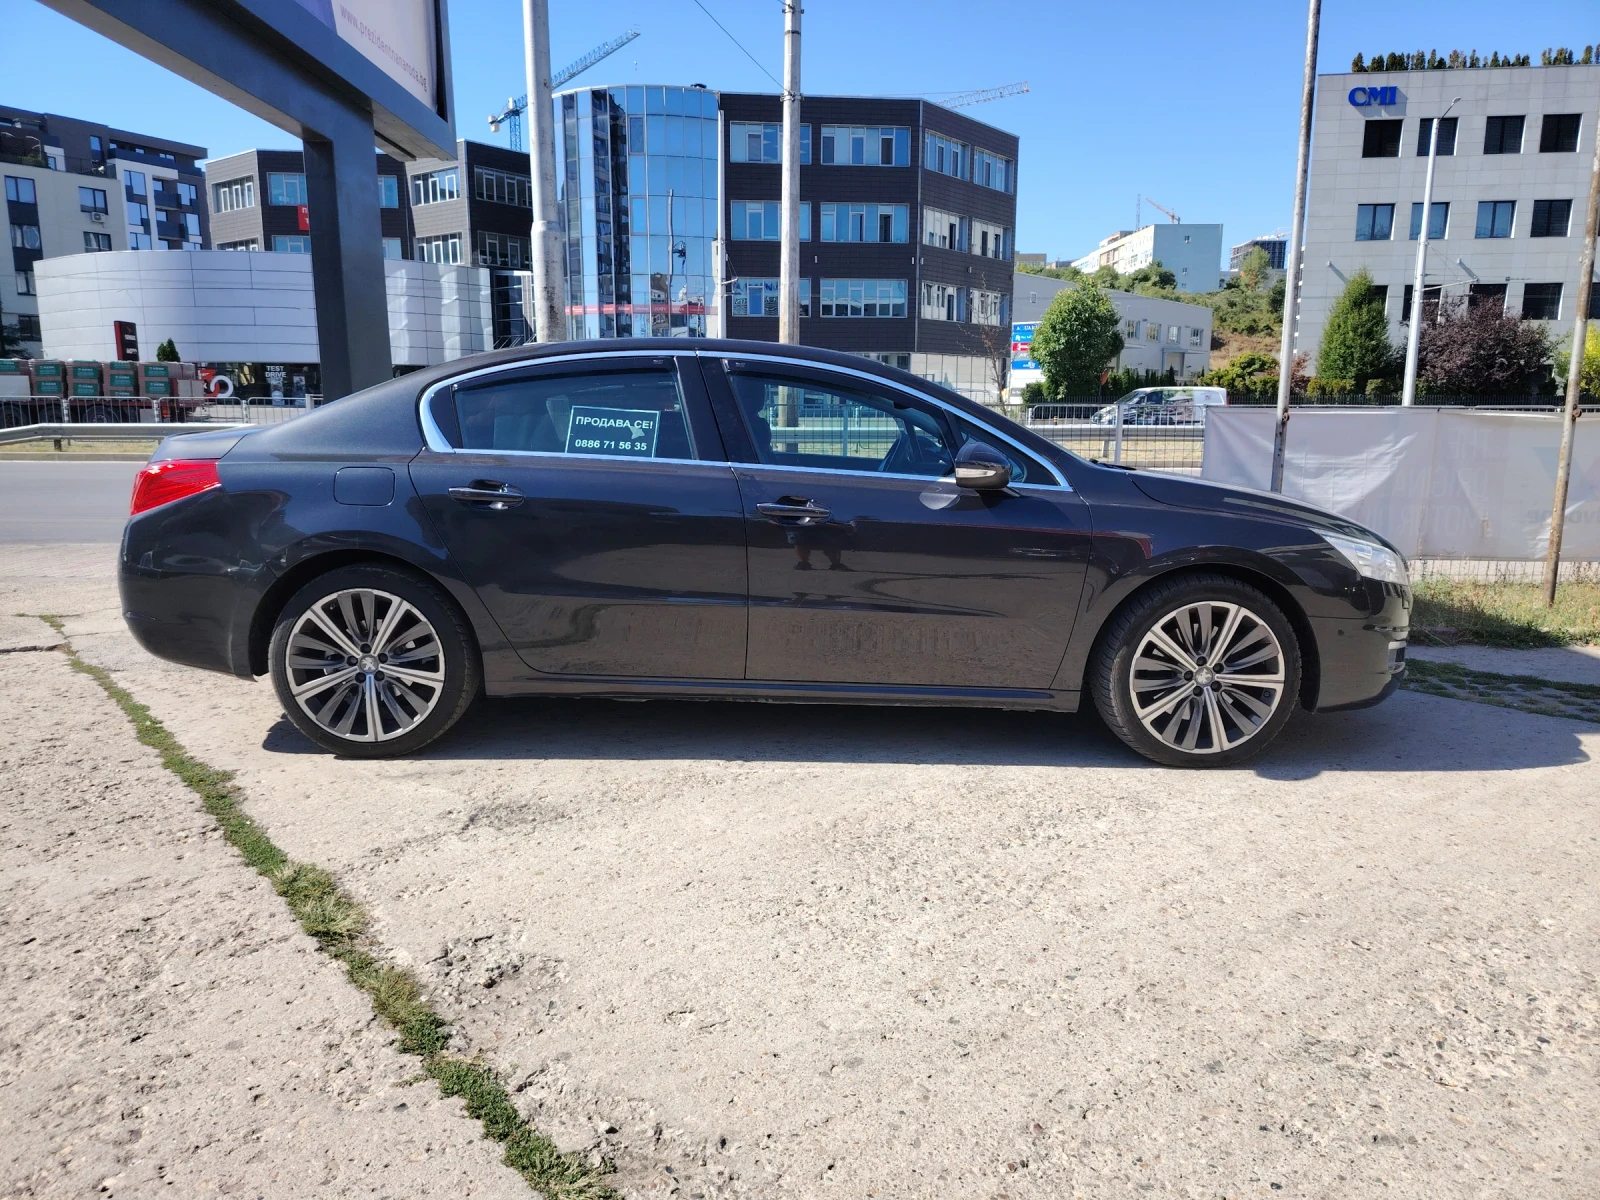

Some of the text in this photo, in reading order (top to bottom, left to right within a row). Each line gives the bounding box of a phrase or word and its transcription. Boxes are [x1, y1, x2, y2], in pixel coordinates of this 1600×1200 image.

[1348, 86, 1398, 106] CMI
[576, 416, 653, 429] ПРОДАВА СЕ!
[575, 439, 647, 451] 0886 71 56 35
